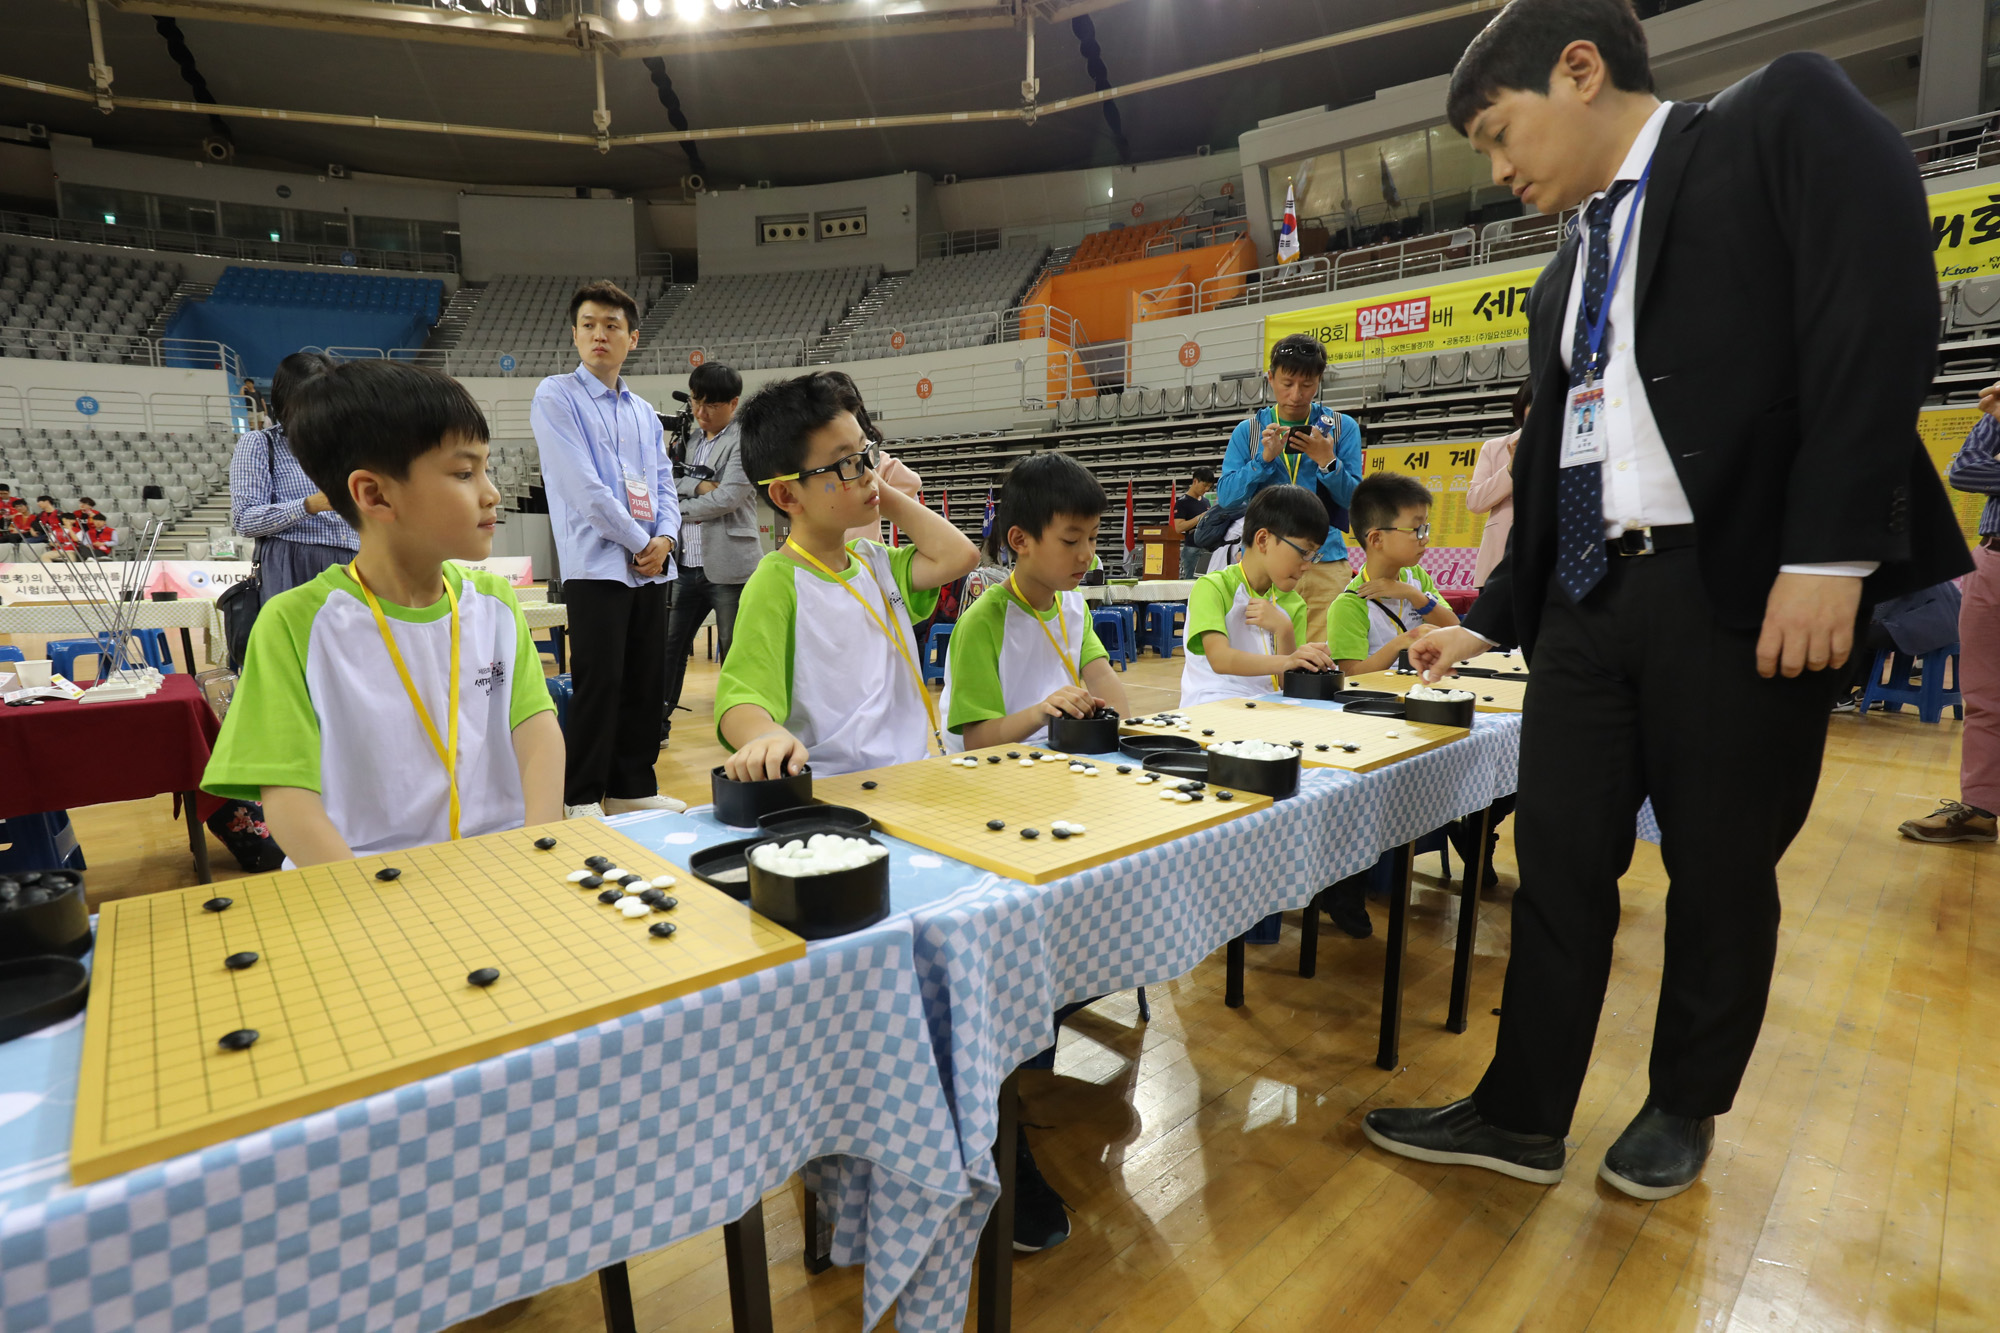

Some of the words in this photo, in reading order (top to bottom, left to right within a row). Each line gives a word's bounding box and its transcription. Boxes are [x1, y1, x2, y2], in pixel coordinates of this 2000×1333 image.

[1941, 264, 1979, 277] Ktoto
[1358, 300, 1426, 338] 일요신문
[1432, 306, 1453, 327] 배
[893, 336, 902, 344] 49
[1184, 348, 1195, 359] 19
[920, 383, 929, 392] 18
[81, 401, 94, 409] 16
[1372, 457, 1385, 470] 배
[631, 498, 650, 509] 기자단
[633, 509, 652, 518] PRESS
